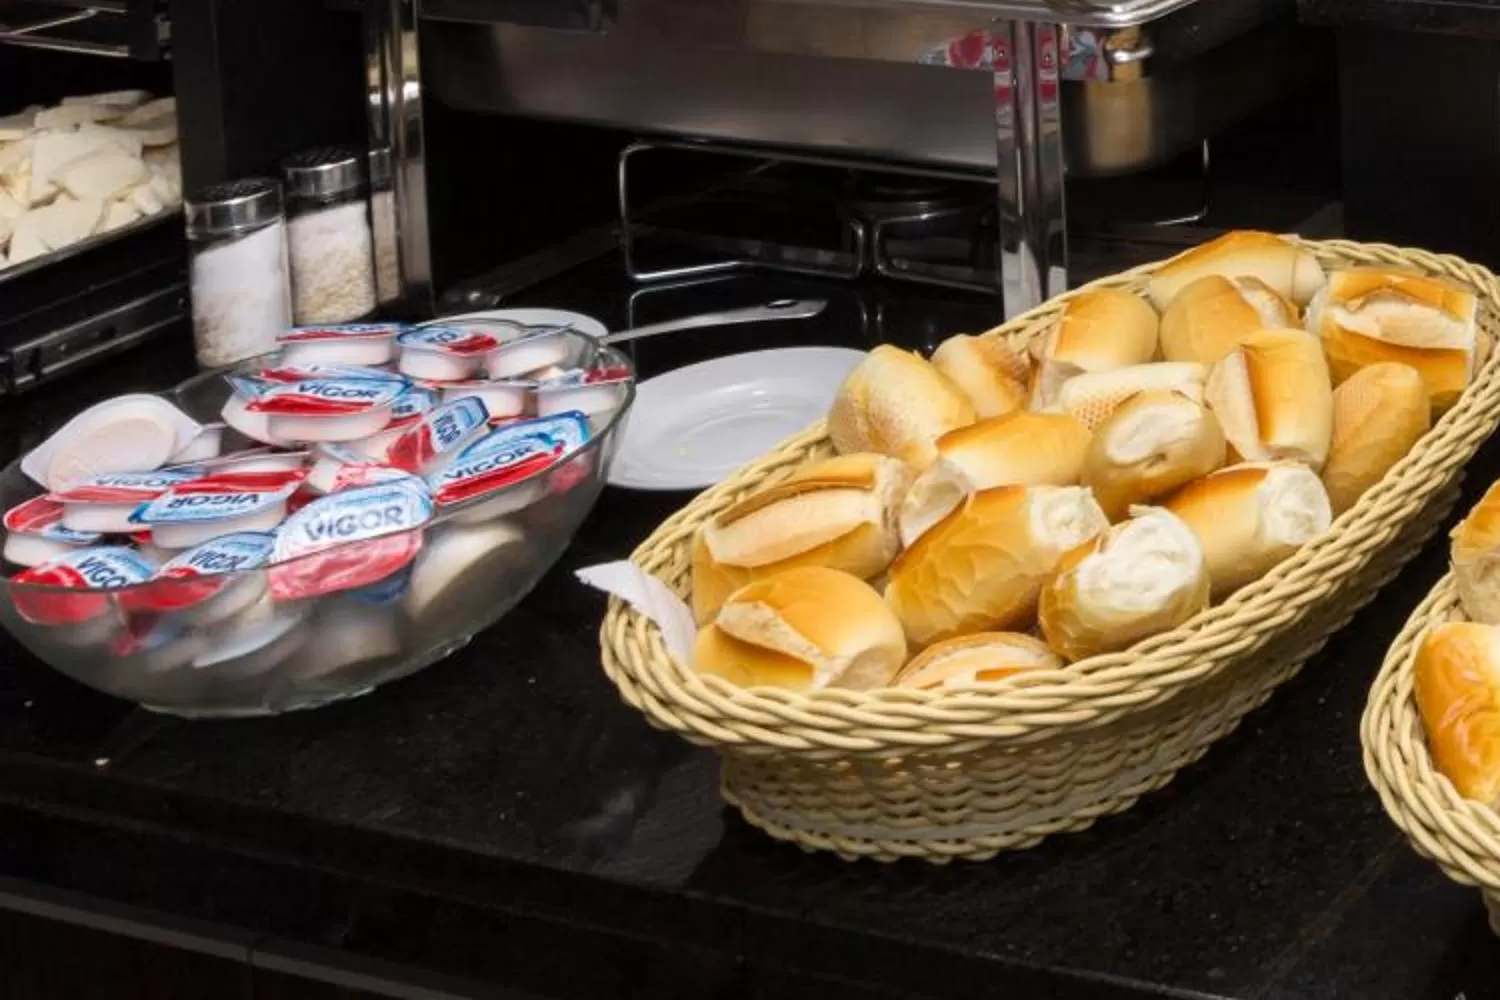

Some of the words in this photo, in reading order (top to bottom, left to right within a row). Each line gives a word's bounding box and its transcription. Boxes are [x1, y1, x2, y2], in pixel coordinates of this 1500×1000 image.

[298, 383, 380, 398] VIGOR
[443, 446, 532, 478] VIGOR
[168, 494, 258, 508] VIGOR
[304, 505, 404, 541] VIGOR
[77, 556, 130, 588] VIGO
